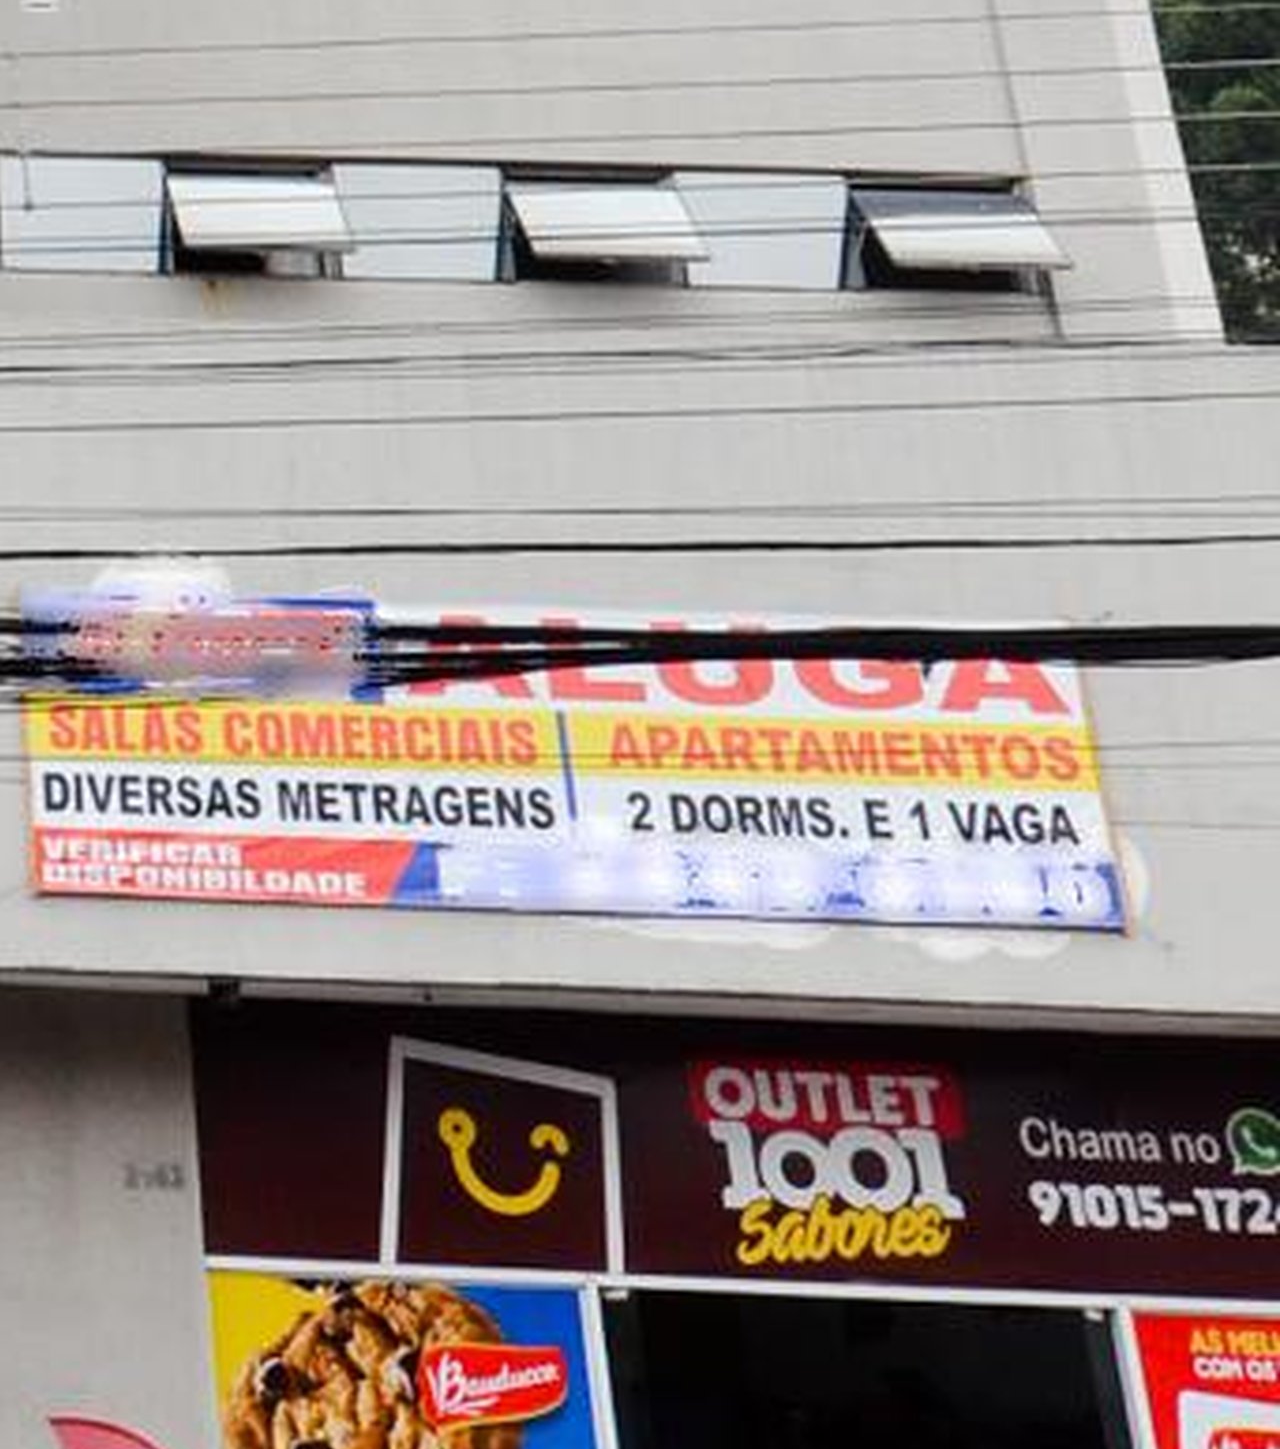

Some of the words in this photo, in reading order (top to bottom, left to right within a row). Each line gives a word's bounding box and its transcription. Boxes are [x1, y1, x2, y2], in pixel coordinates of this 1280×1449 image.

[48, 702, 204, 753] SALAS
[223, 708, 538, 765] COMERCIAIS
[610, 723, 1081, 782] APARTAMENTOS
[42, 771, 263, 820] DIVERSAS
[278, 780, 556, 829] METRAGENS
[629, 792, 656, 832] 2
[672, 794, 850, 840] DORMS.
[865, 800, 894, 841] E
[909, 801, 931, 842] 1
[948, 801, 1081, 847] VAGA
[703, 1065, 941, 1127] OUTLET
[709, 1118, 966, 1220] 1001
[1019, 1115, 1162, 1163] Chama
[1169, 1131, 1221, 1165] no
[736, 1194, 952, 1266] Sabores
[1027, 1180, 1280, 1235] 91015-172
